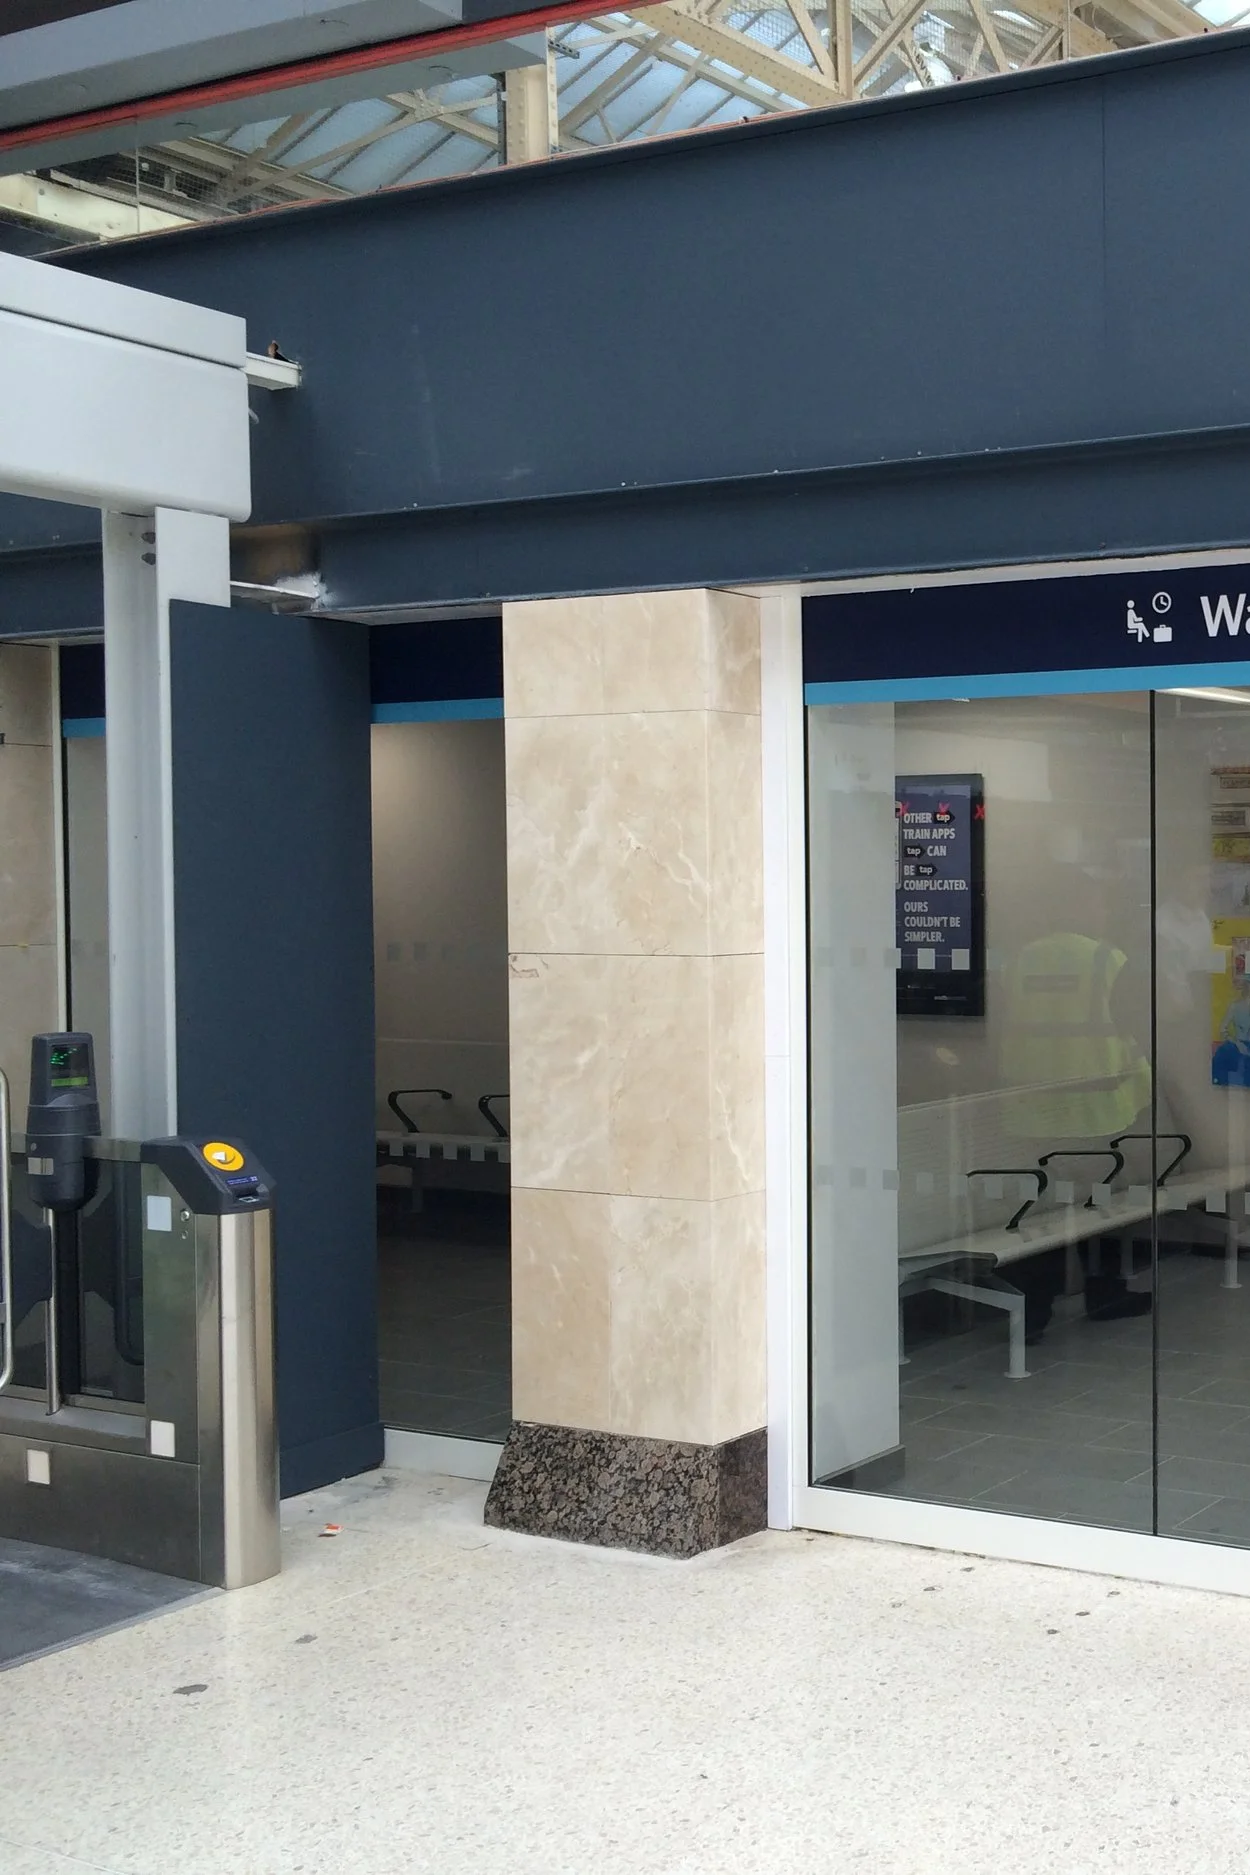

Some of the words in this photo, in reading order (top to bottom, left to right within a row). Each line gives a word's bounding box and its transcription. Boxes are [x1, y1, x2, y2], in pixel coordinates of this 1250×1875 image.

[903, 812, 932, 824] OTHER
[935, 812, 950, 823] tap
[903, 829, 931, 840] TRAIN
[932, 829, 956, 840] APPS
[906, 847, 921, 856] tap
[927, 845, 947, 857] CAN
[904, 864, 915, 876] BE
[919, 865, 933, 875] tap
[904, 880, 968, 891] COMPLICATED.
[904, 901, 928, 913] OURS
[904, 917, 949, 928] COULDN'T
[950, 917, 960, 928] BE
[904, 931, 945, 943] SIMPLER.
